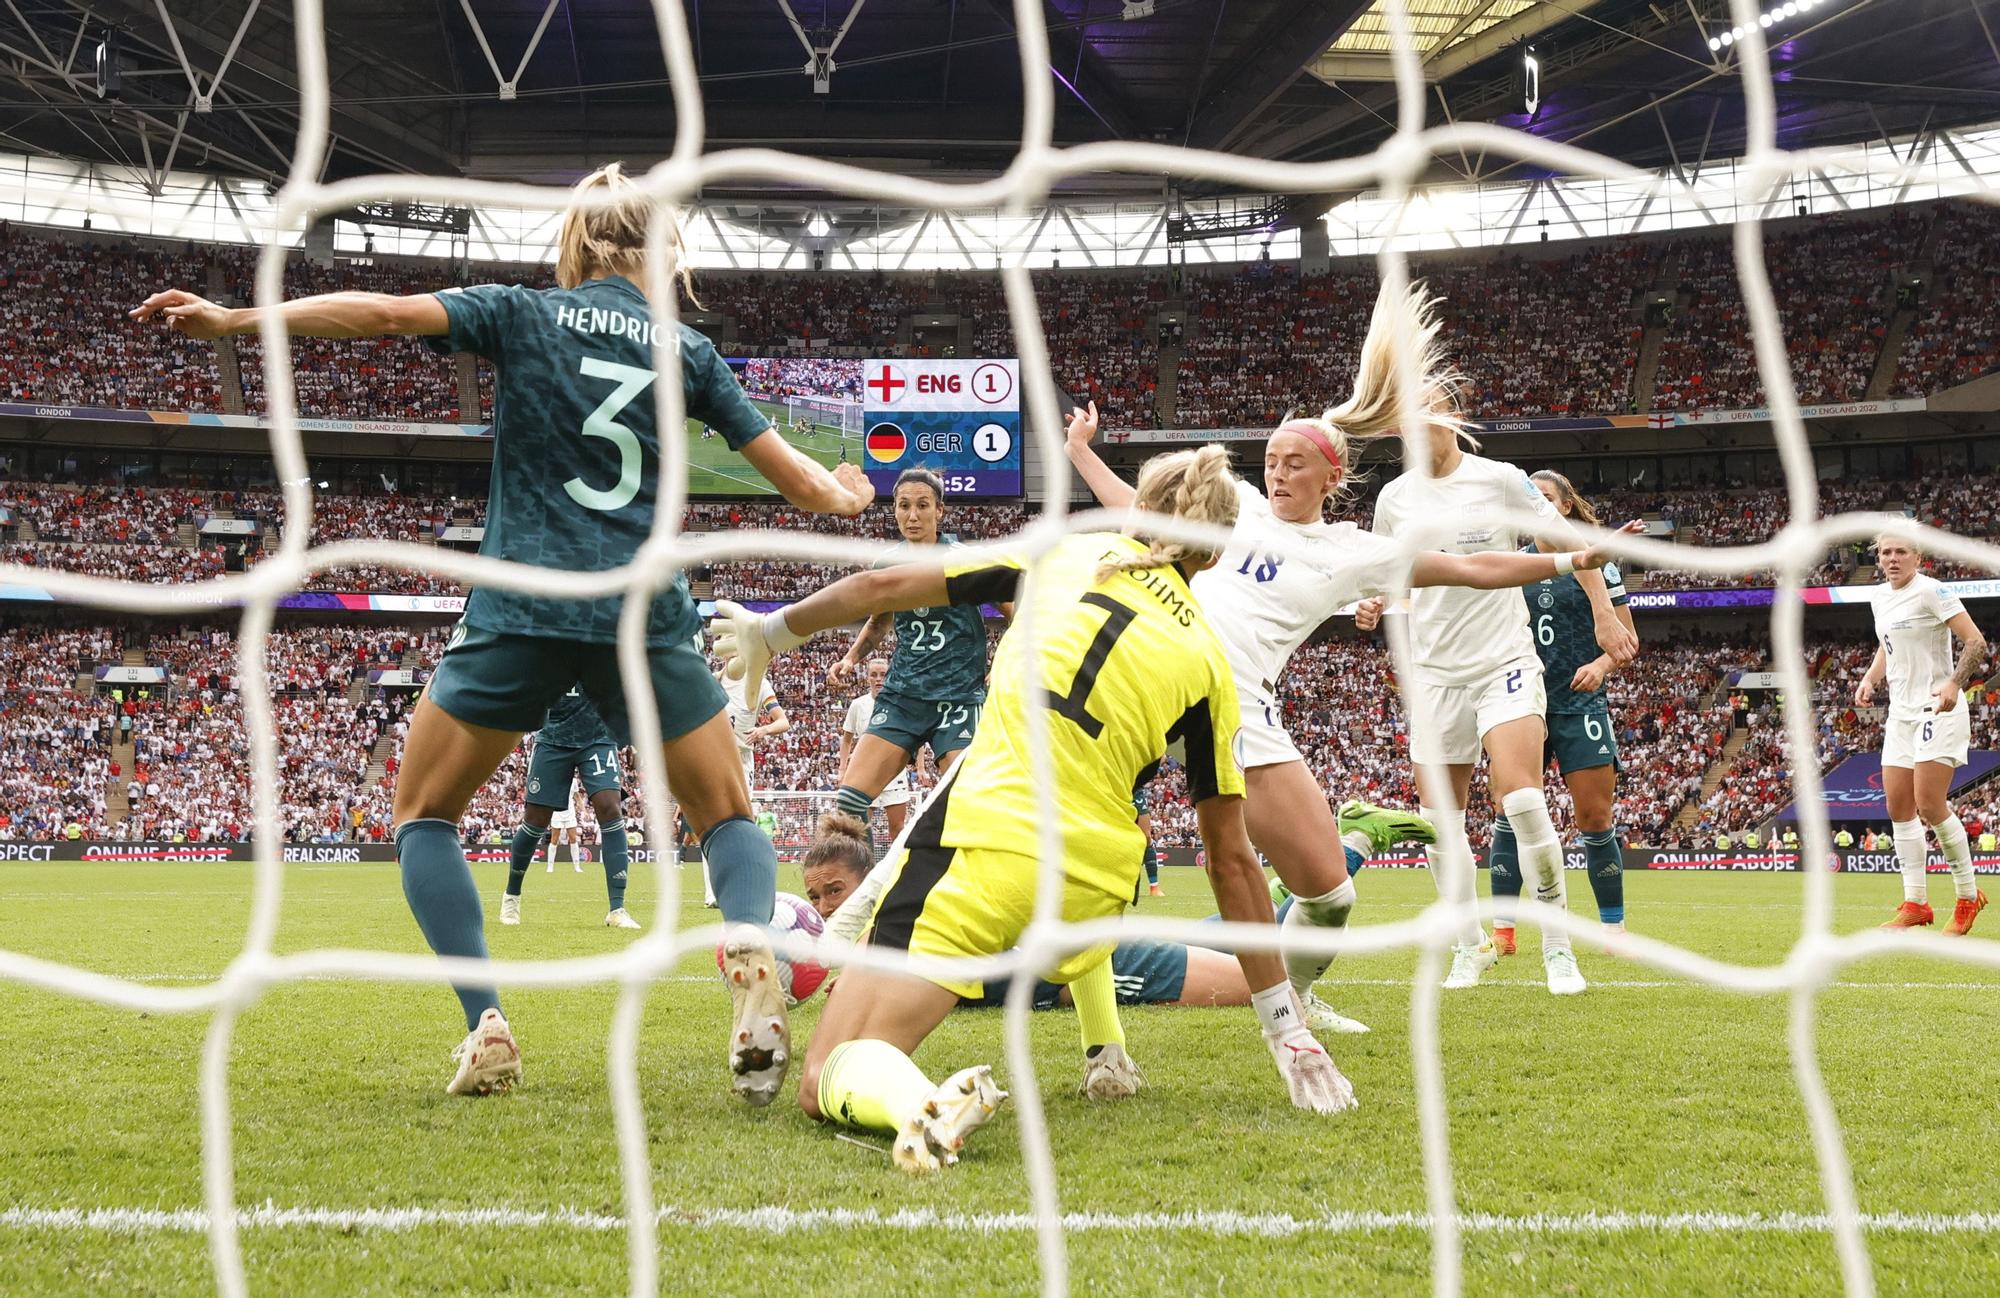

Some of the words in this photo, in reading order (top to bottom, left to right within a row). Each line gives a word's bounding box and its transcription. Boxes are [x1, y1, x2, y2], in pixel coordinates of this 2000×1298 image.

[556, 305, 681, 356] HENDRICH
[917, 374, 962, 393] ENG
[985, 373, 997, 393] 1
[35, 407, 72, 417] LONDON
[1819, 406, 1856, 415] ENGLAND
[1859, 404, 1879, 413] 2022
[331, 421, 353, 430] EURO
[354, 423, 391, 431] ENGLAND
[392, 424, 410, 432] 2022
[563, 356, 659, 511] 3
[1165, 432, 1186, 440] UEFA
[1186, 431, 1223, 439] WOMEN'S
[1224, 430, 1245, 439] EURO
[1246, 429, 1274, 438] ENGLA
[1495, 422, 1531, 431] LONDON
[916, 432, 963, 453] GER
[985, 432, 997, 452] 1
[943, 476, 976, 492] :52
[1236, 549, 1285, 583] 18
[170, 591, 224, 605] LONDON
[1098, 551, 1196, 628] FOHMS
[433, 599, 464, 609] UEFA
[910, 620, 946, 651] 23
[1537, 614, 1555, 646] 6
[1041, 592, 1138, 740] 1
[1506, 669, 1522, 694] 2
[937, 702, 969, 729] 23
[1583, 714, 1603, 741] 6
[1922, 720, 1934, 742] 6
[589, 750, 618, 776] 14
[86, 846, 159, 862] ONLINE
[164, 846, 228, 862] ABUSE
[283, 847, 361, 863] REALSCARS
[1653, 852, 1727, 869] ONLINE
[1732, 854, 1796, 870] ABUSE
[1847, 855, 1900, 872] RESPEC
[1273, 1005, 1290, 1021] MF
